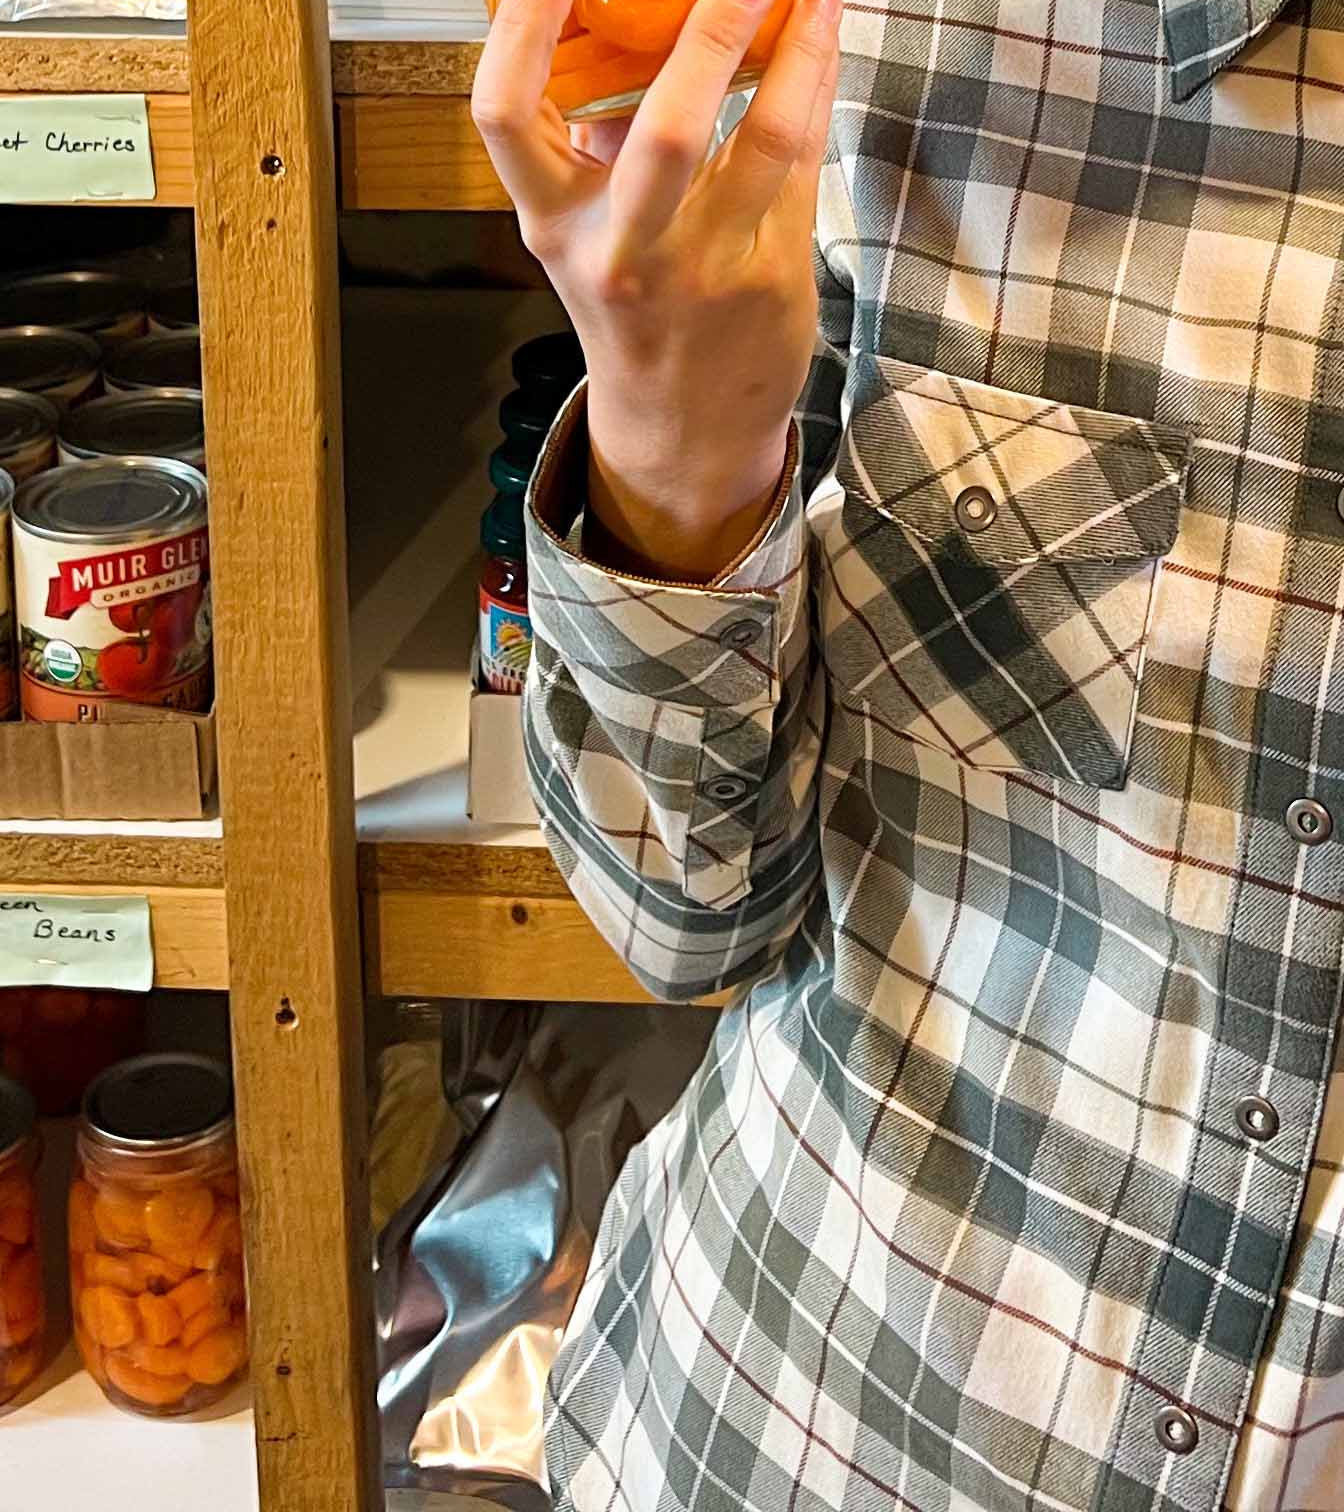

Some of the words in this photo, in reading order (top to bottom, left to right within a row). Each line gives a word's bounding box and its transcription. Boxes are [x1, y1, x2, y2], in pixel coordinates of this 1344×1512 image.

[45, 131, 136, 153] Cherries
[71, 554, 147, 592] MUIR
[103, 569, 196, 602] ORGANIC
[33, 918, 116, 943] Beans
